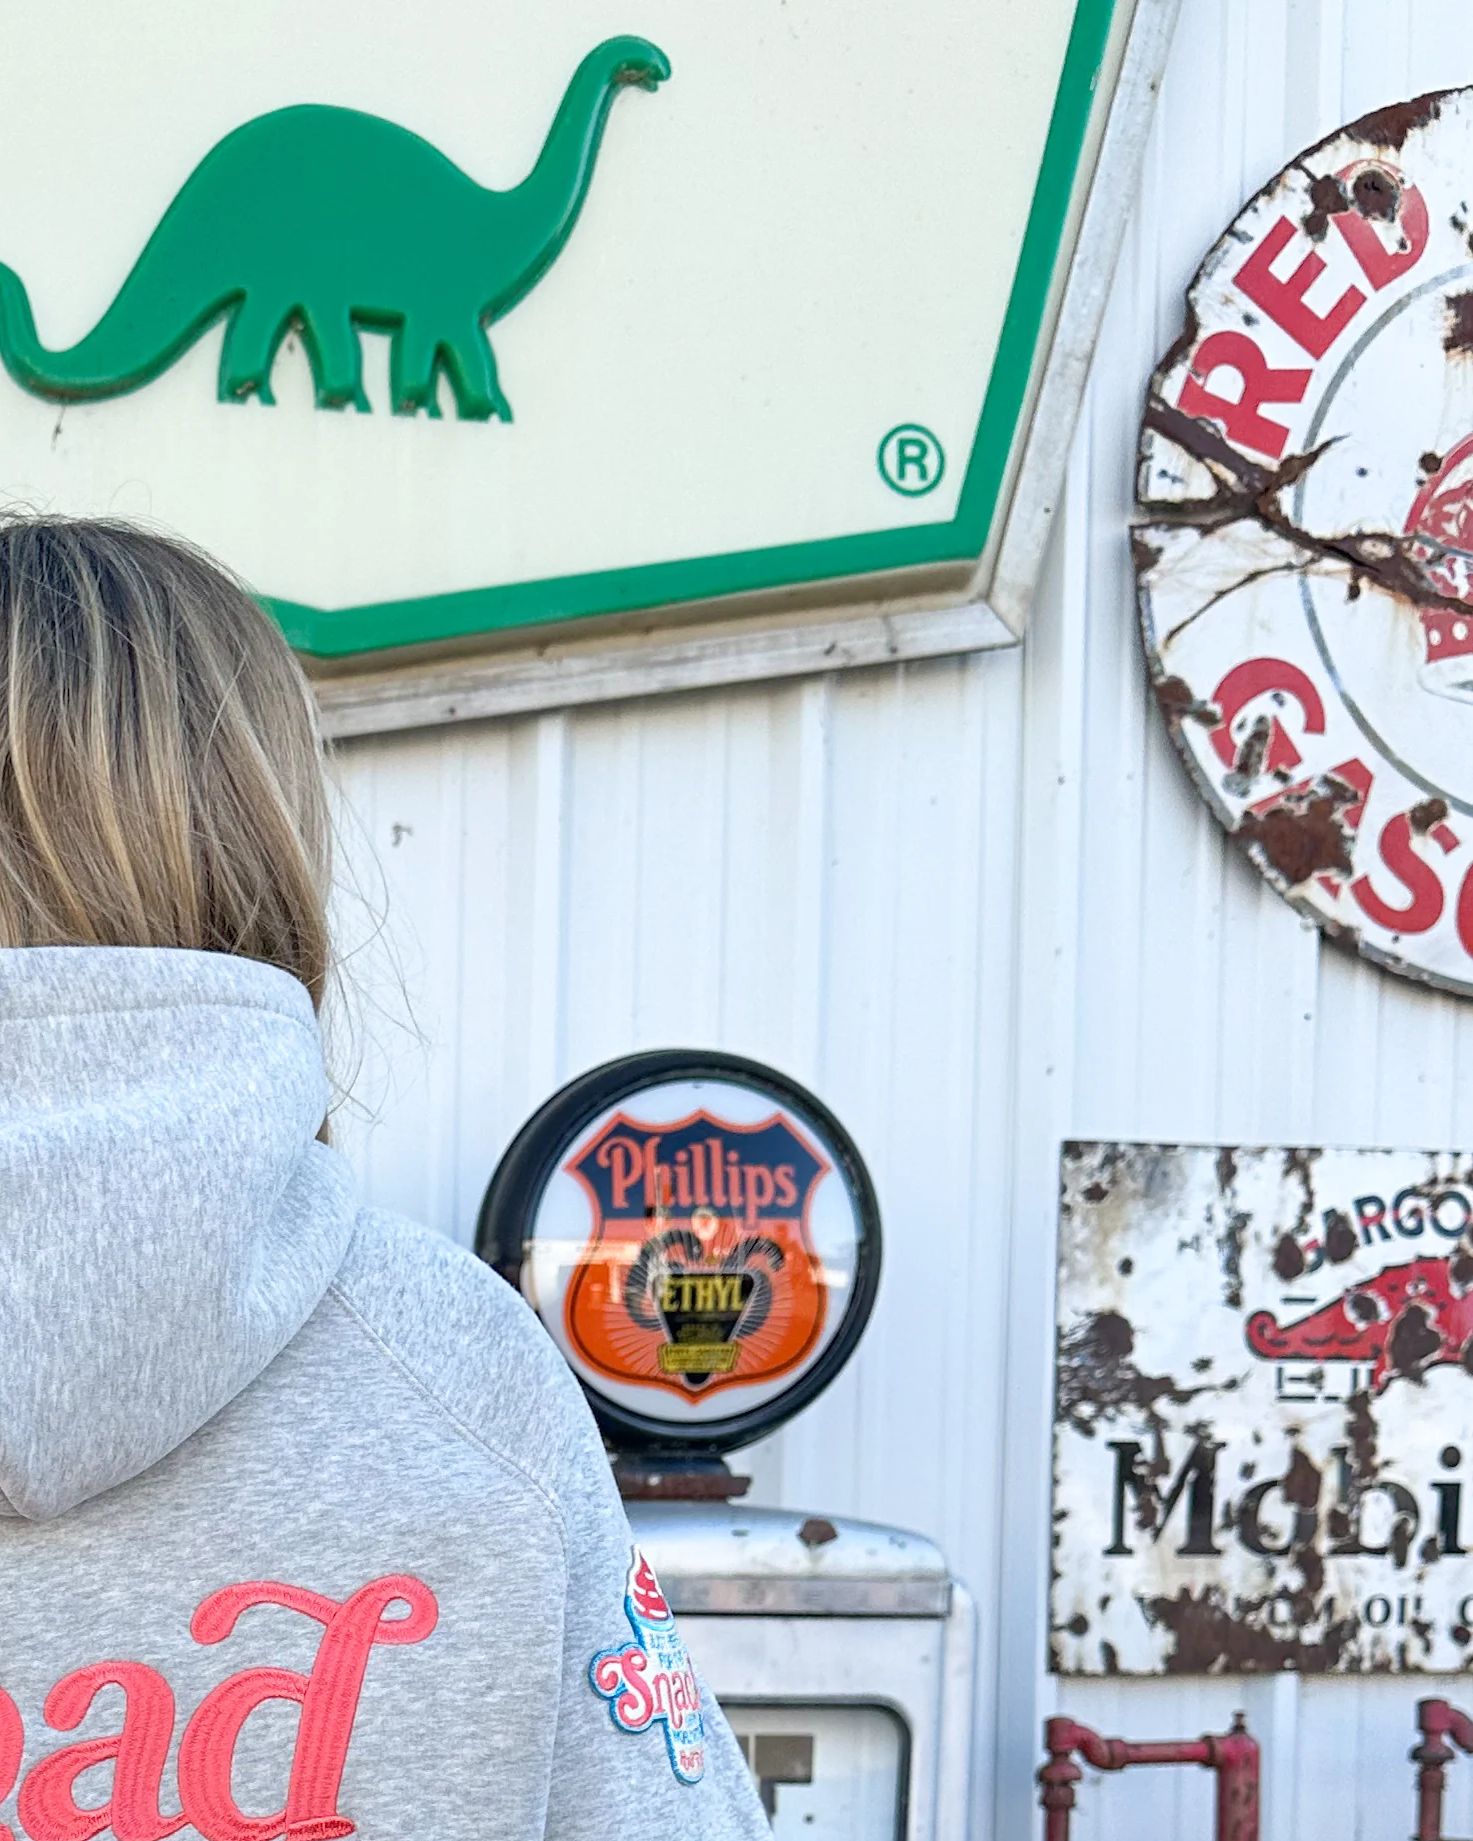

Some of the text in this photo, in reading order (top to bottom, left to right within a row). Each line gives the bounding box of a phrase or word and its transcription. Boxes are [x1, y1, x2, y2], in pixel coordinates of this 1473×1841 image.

[1175, 158, 1429, 460] RED
[1208, 656, 1473, 965] GS
[596, 1136, 798, 1230] Phillips
[1279, 1188, 1472, 1275] RGO
[661, 1276, 745, 1312] ETHYL
